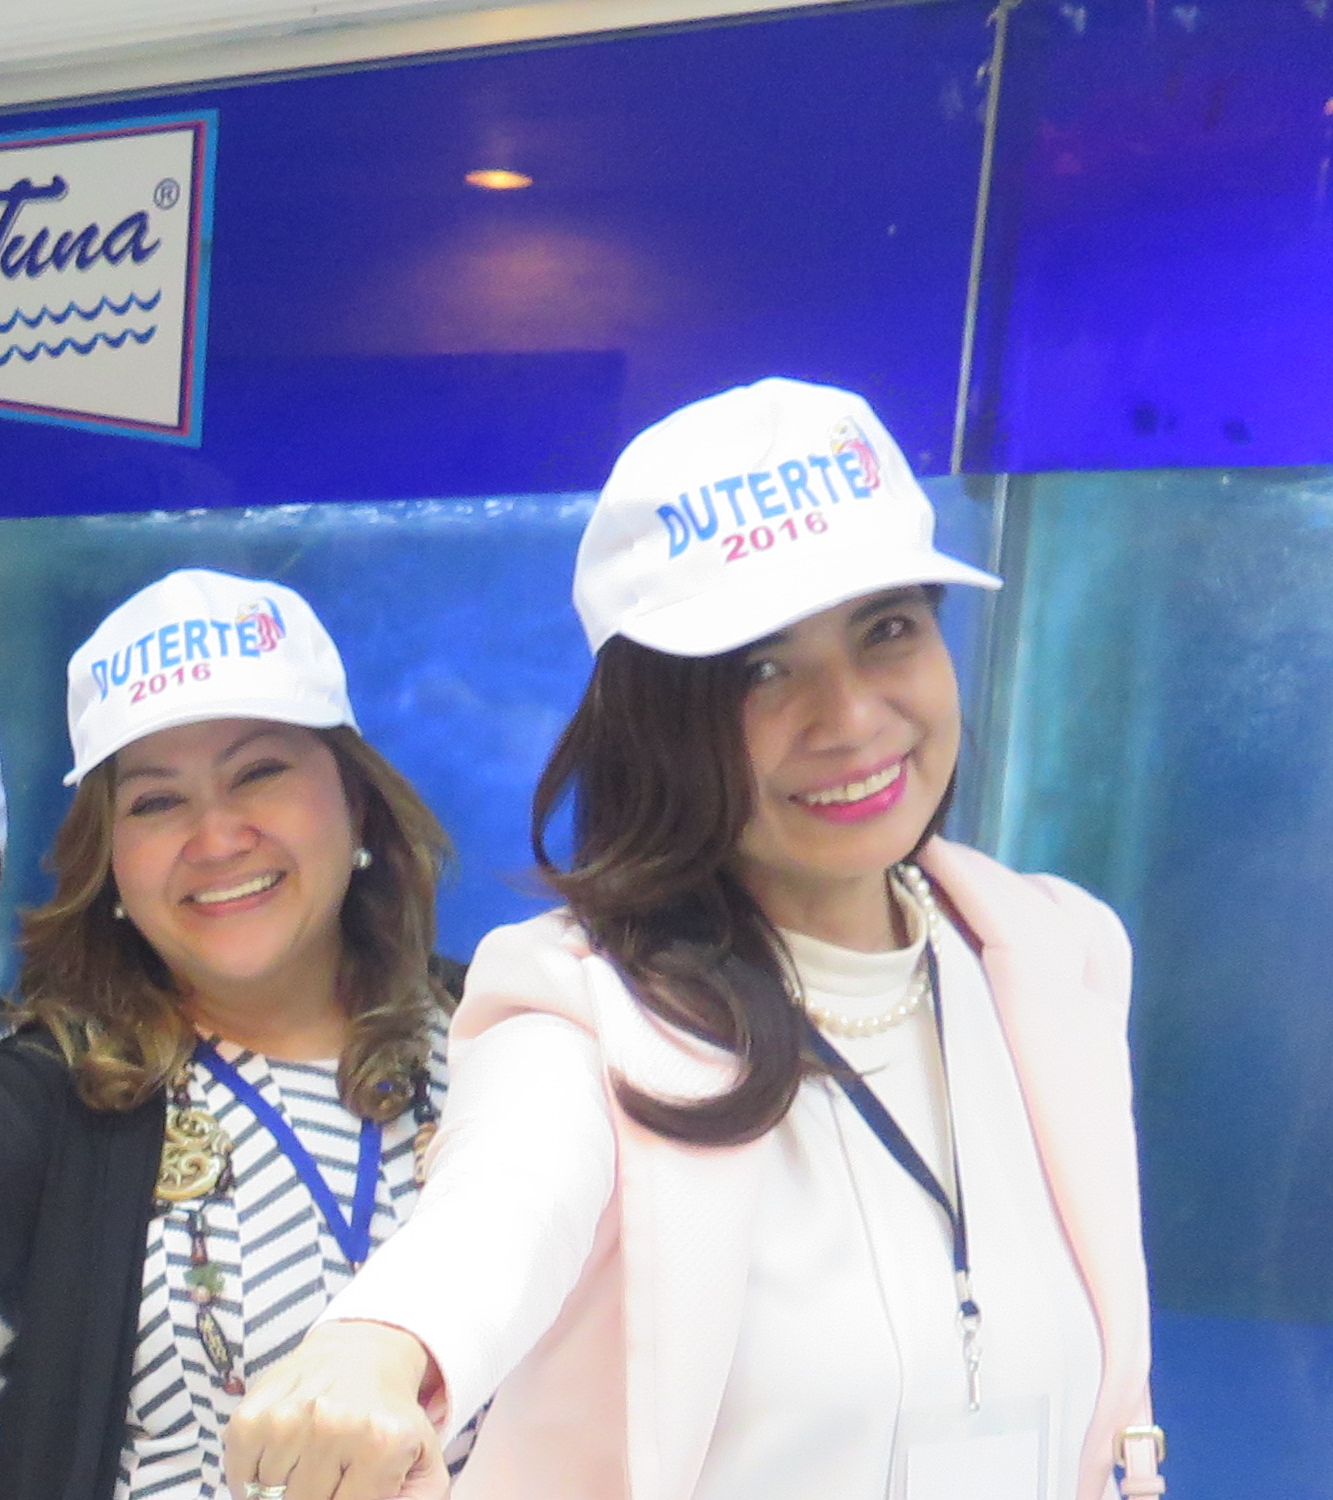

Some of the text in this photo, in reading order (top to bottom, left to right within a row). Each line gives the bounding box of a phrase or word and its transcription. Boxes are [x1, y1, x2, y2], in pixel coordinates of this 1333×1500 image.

[656, 451, 873, 559] DUTERTE
[721, 511, 830, 564] 2016
[91, 618, 262, 702] DUTERTE
[129, 662, 212, 705] 2016
